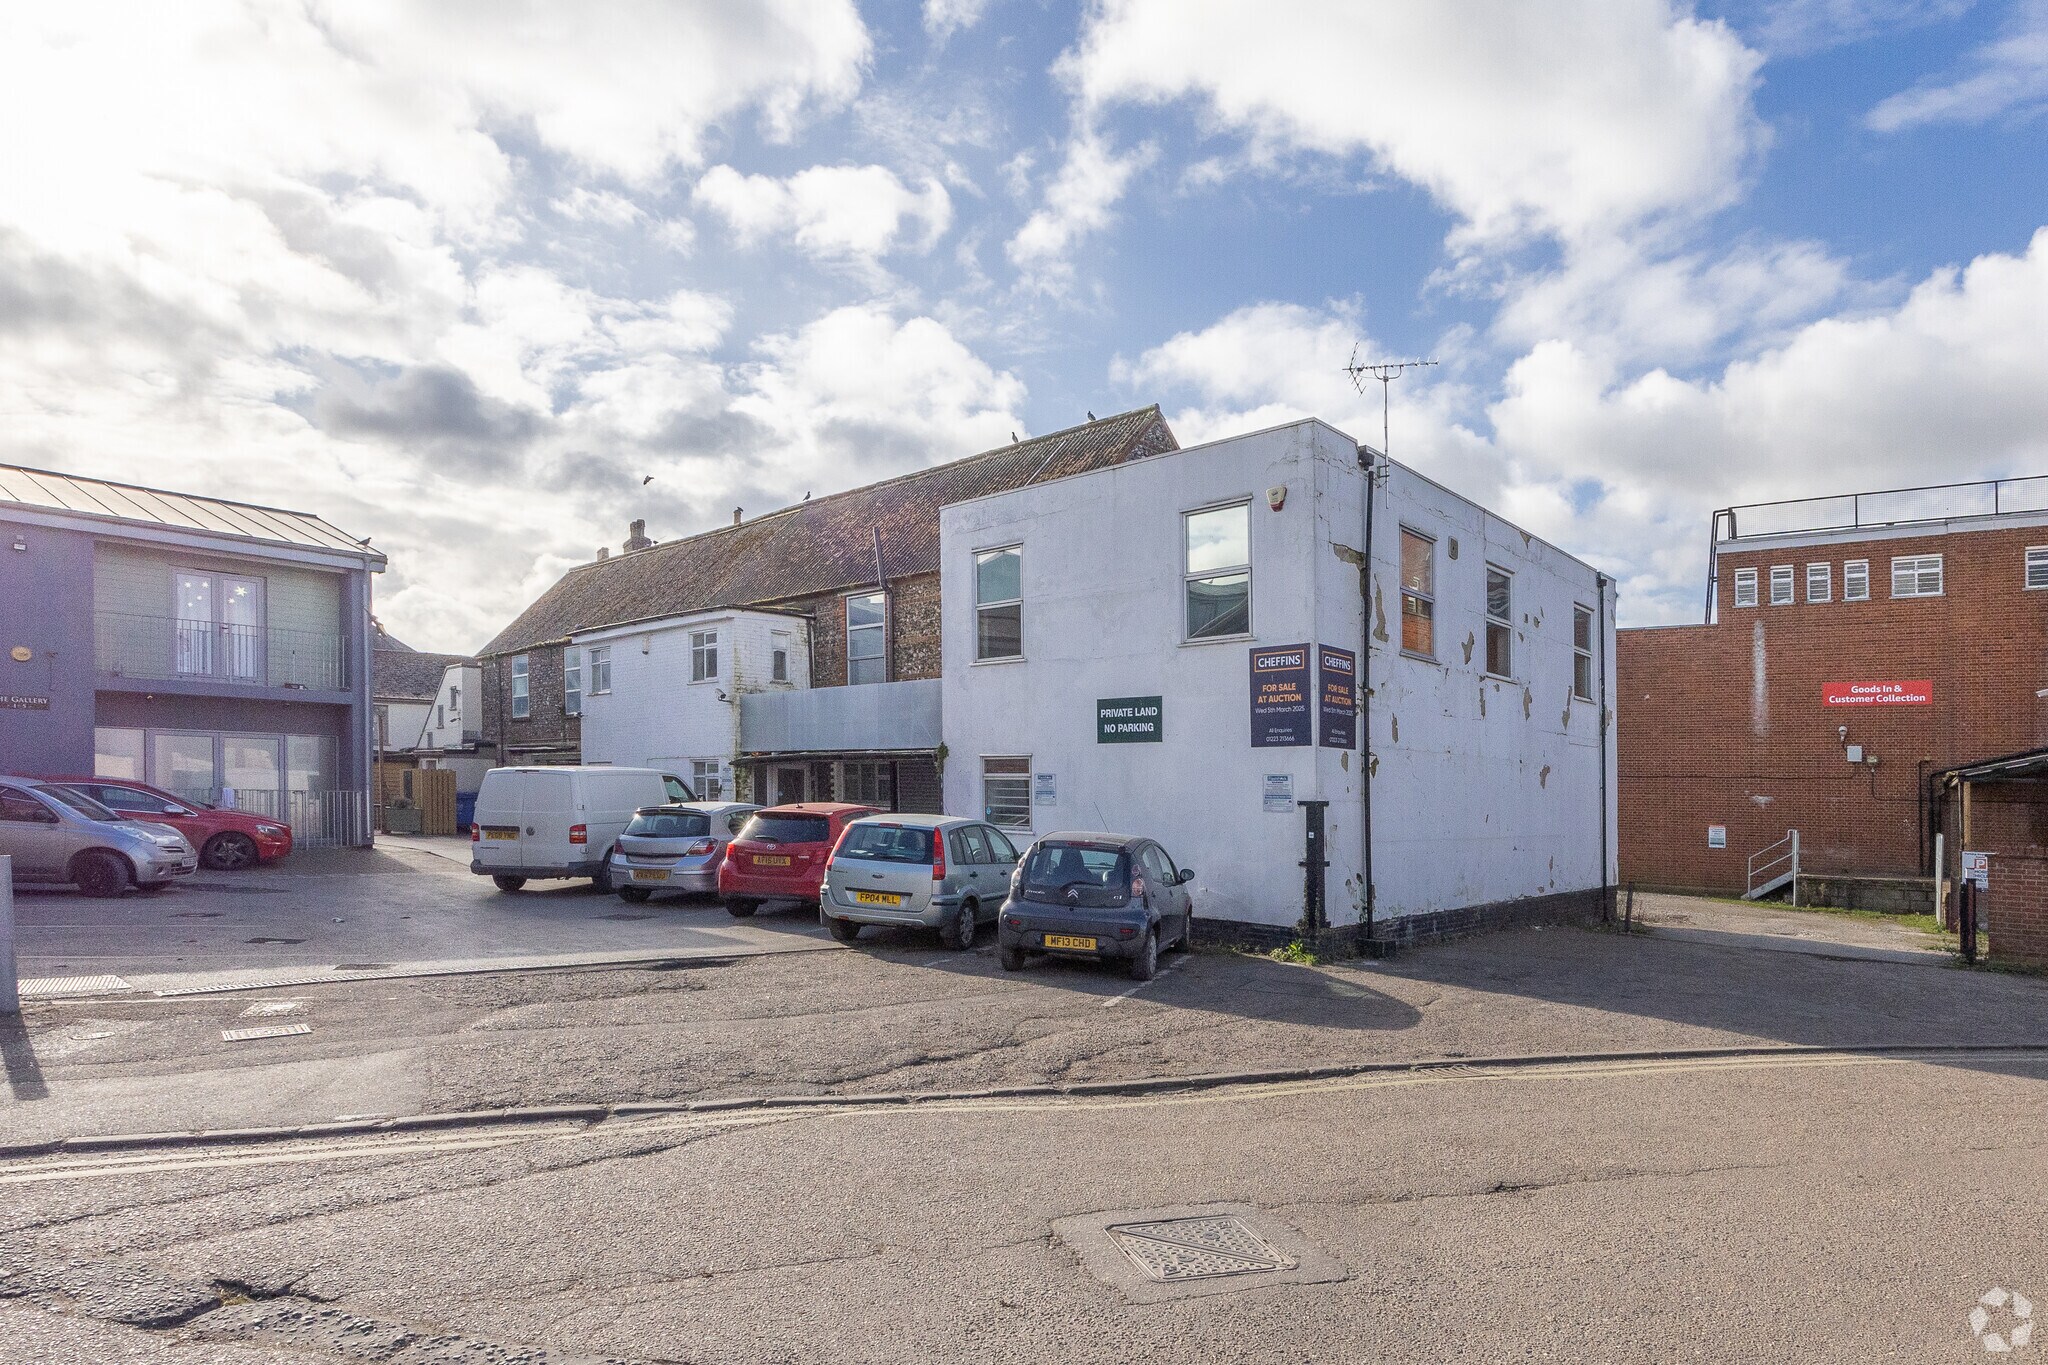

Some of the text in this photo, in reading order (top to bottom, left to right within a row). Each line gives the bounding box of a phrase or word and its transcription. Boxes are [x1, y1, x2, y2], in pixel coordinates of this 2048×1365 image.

[1258, 654, 1300, 668] CHEFFINS
[1324, 656, 1351, 670] CHEFFINS
[1262, 683, 1296, 692] FOR SALE
[1328, 684, 1348, 695] FOR SALE
[1258, 694, 1302, 704] AT AUCTION
[1334, 696, 1352, 705] AUCTION
[1876, 694, 1926, 702] Collection
[1101, 707, 1158, 718] PRIVATE LAND
[1104, 723, 1154, 733] NO PARKING
[860, 893, 896, 904] FP04 MLL
[1050, 937, 1091, 948] MF13 CHD
